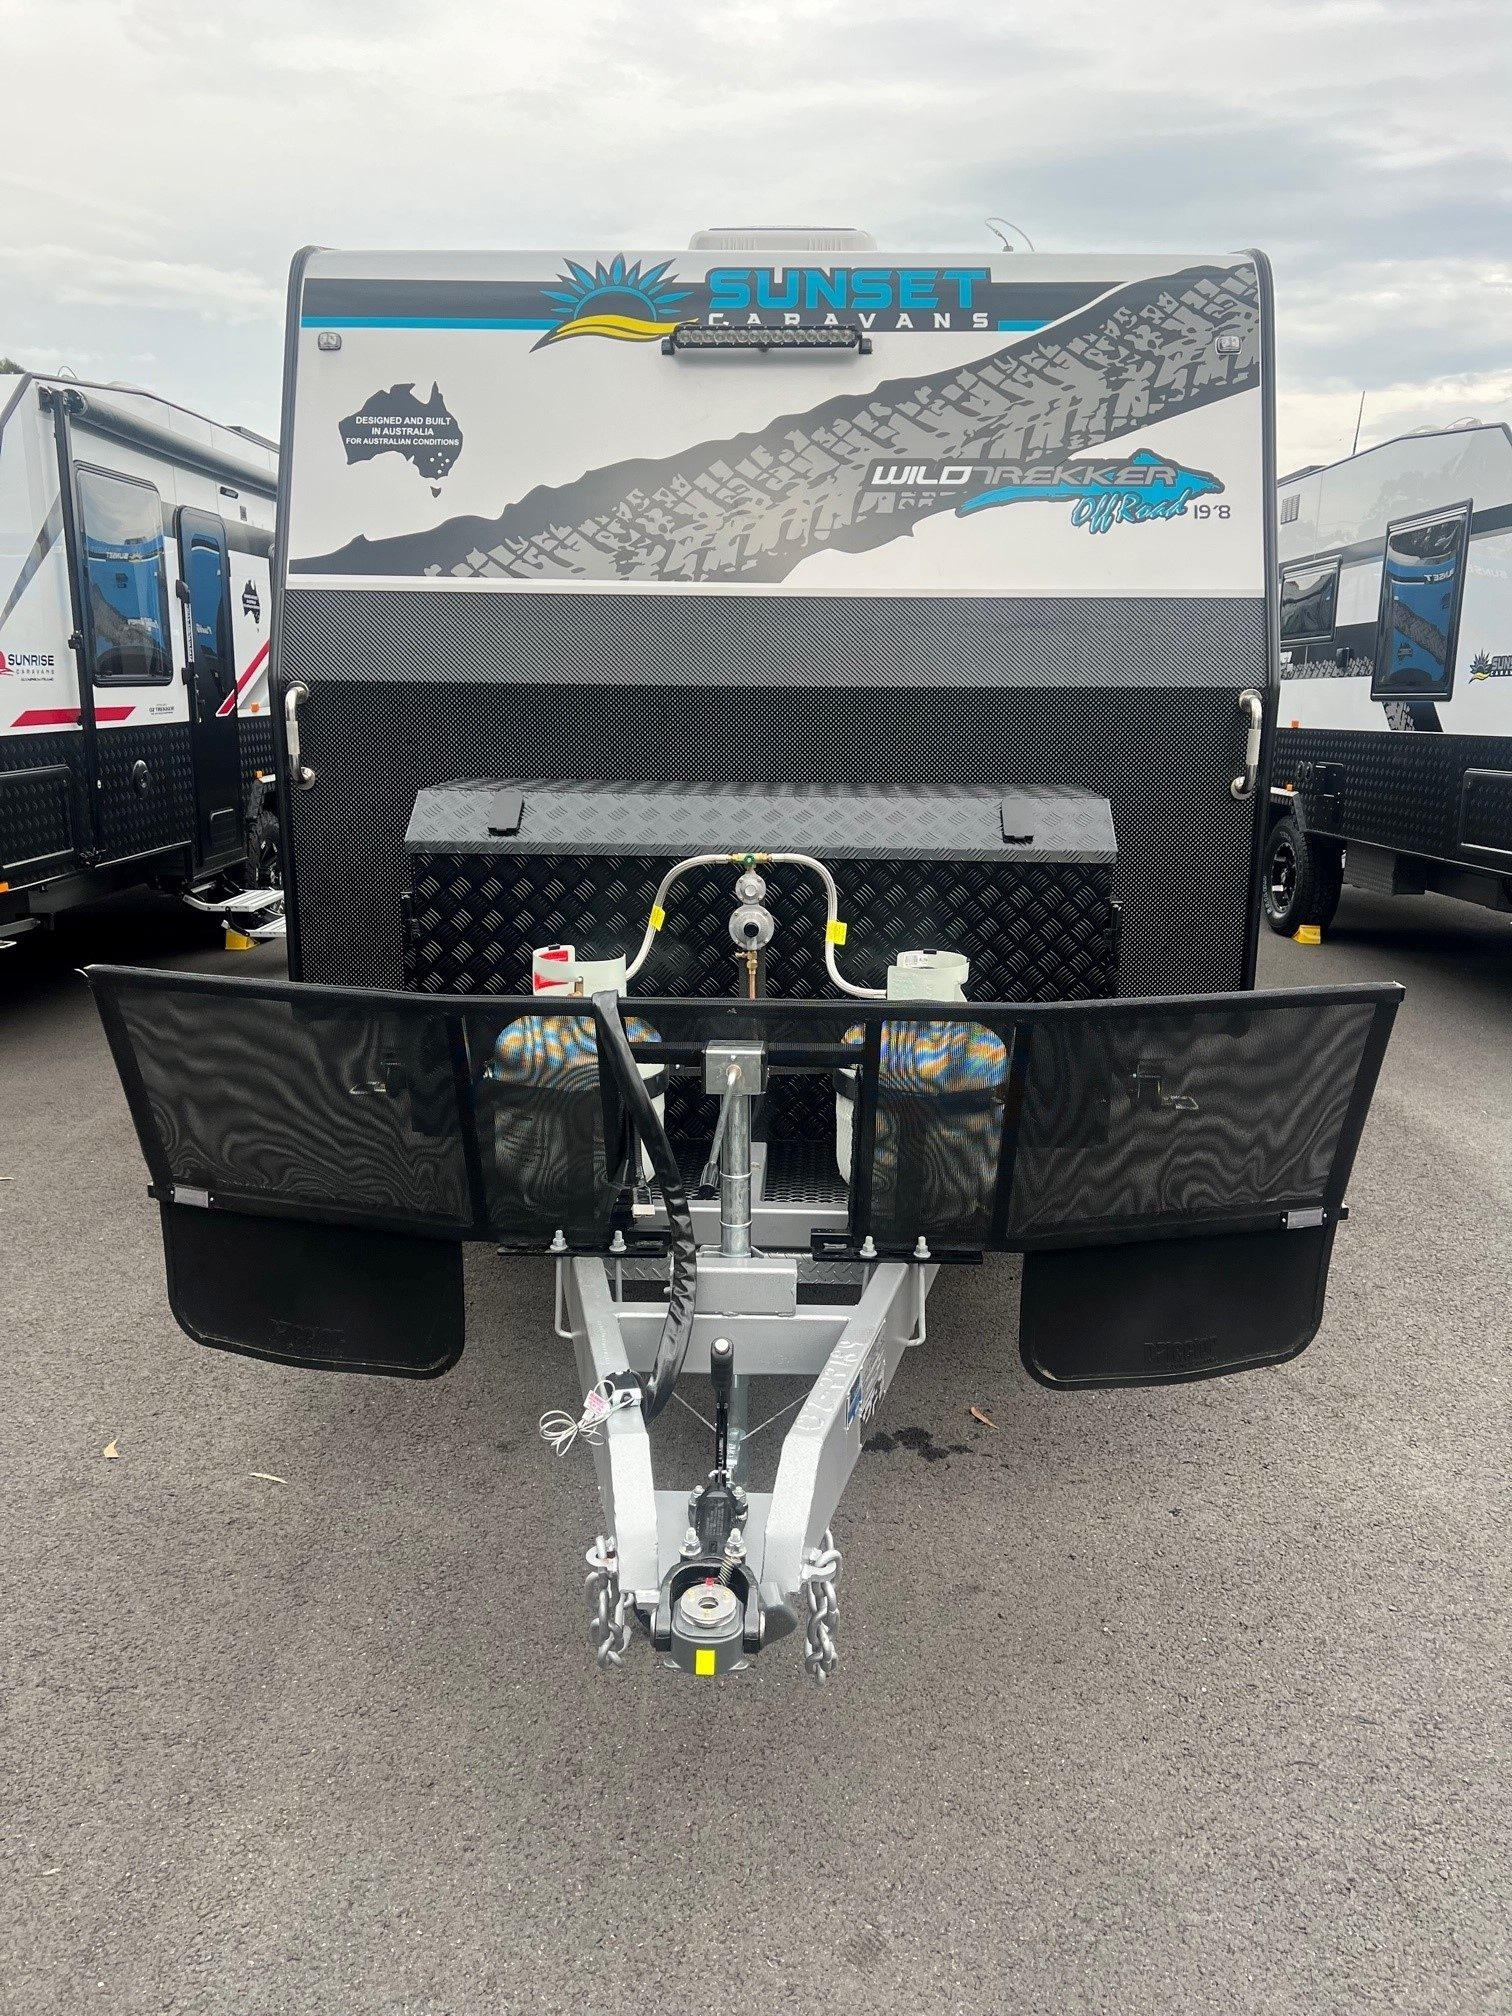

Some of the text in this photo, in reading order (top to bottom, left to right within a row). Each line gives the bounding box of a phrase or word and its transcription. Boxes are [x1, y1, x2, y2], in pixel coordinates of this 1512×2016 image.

[707, 268, 989, 310] SUNSET
[708, 312, 988, 328] CARAVANS
[355, 416, 452, 426] DESIGNED AND BUILT
[371, 427, 435, 436] IN AUSTRALIA
[345, 437, 460, 446] FOR AUSTRALIAN CONDITIONS
[7, 653, 55, 667] SUNRISE
[1491, 656, 1512, 671] SUN
